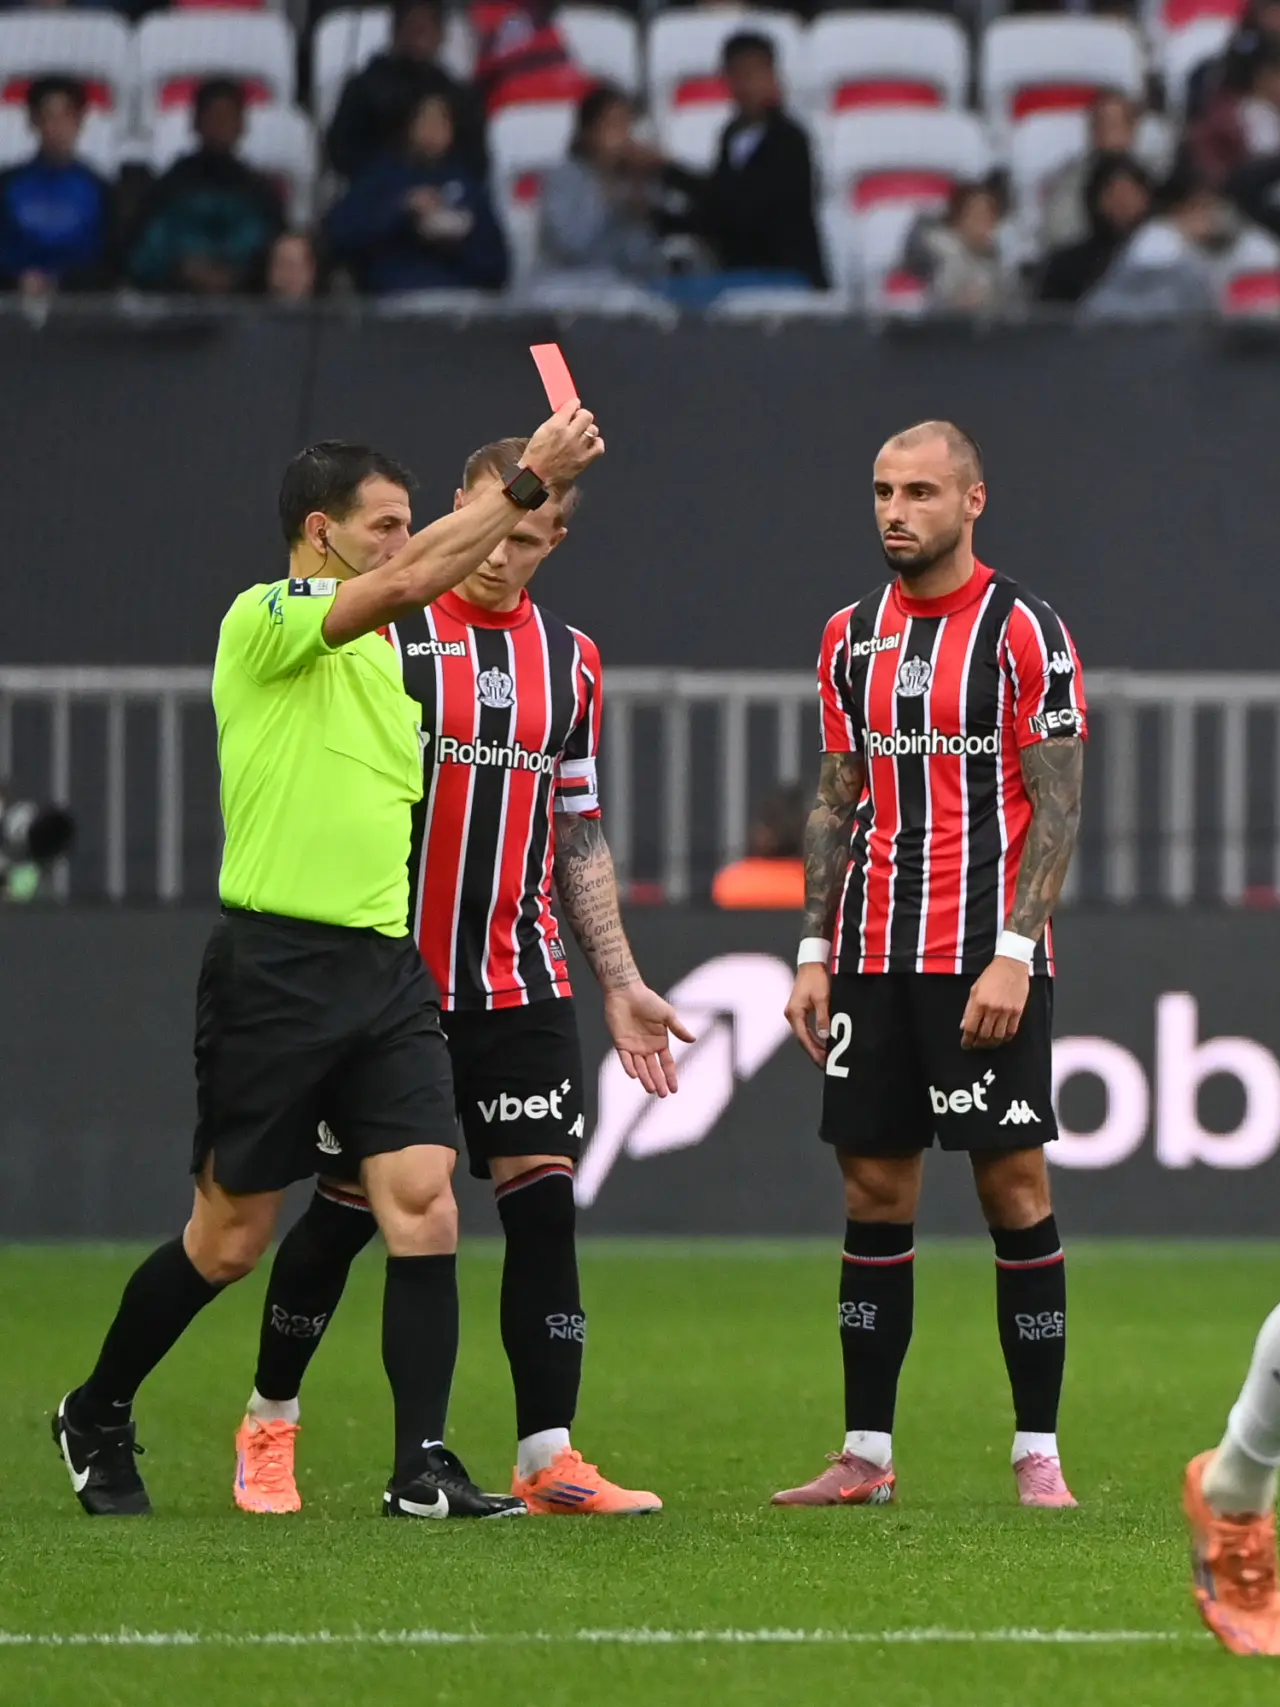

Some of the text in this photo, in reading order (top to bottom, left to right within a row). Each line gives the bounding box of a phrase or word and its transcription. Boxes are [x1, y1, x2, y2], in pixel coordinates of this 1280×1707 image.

[406, 639, 466, 657] actual
[852, 632, 901, 657] actual
[870, 727, 999, 758] Robinhood
[438, 736, 556, 775] Robinhoo
[826, 1012, 852, 1078] 2
[477, 1087, 564, 1123] vbet
[837, 1301, 878, 1316] GC
[545, 1313, 586, 1329] OG
[838, 1313, 875, 1330] ICE
[1019, 1324, 1064, 1341] NICE
